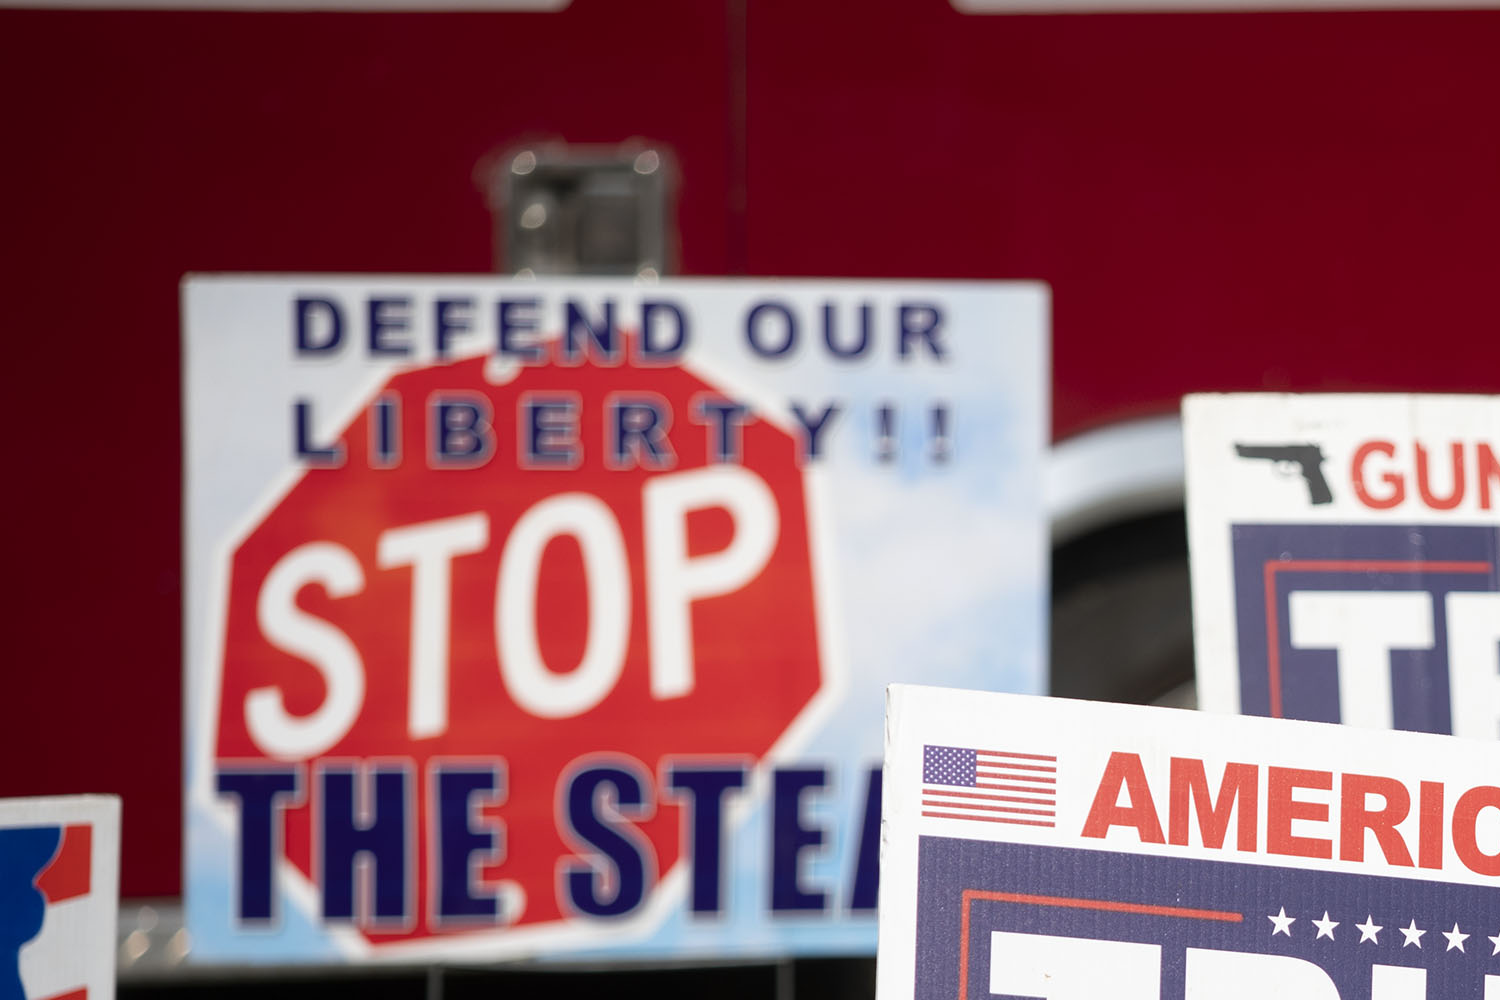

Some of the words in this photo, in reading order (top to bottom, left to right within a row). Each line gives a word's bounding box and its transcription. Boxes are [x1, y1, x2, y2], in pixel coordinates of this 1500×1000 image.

[292, 297, 692, 360] DEFEND
[744, 299, 950, 361] OUR
[292, 397, 952, 468] LIBERTY!!
[243, 464, 781, 761] STOP
[213, 764, 503, 926] THE
